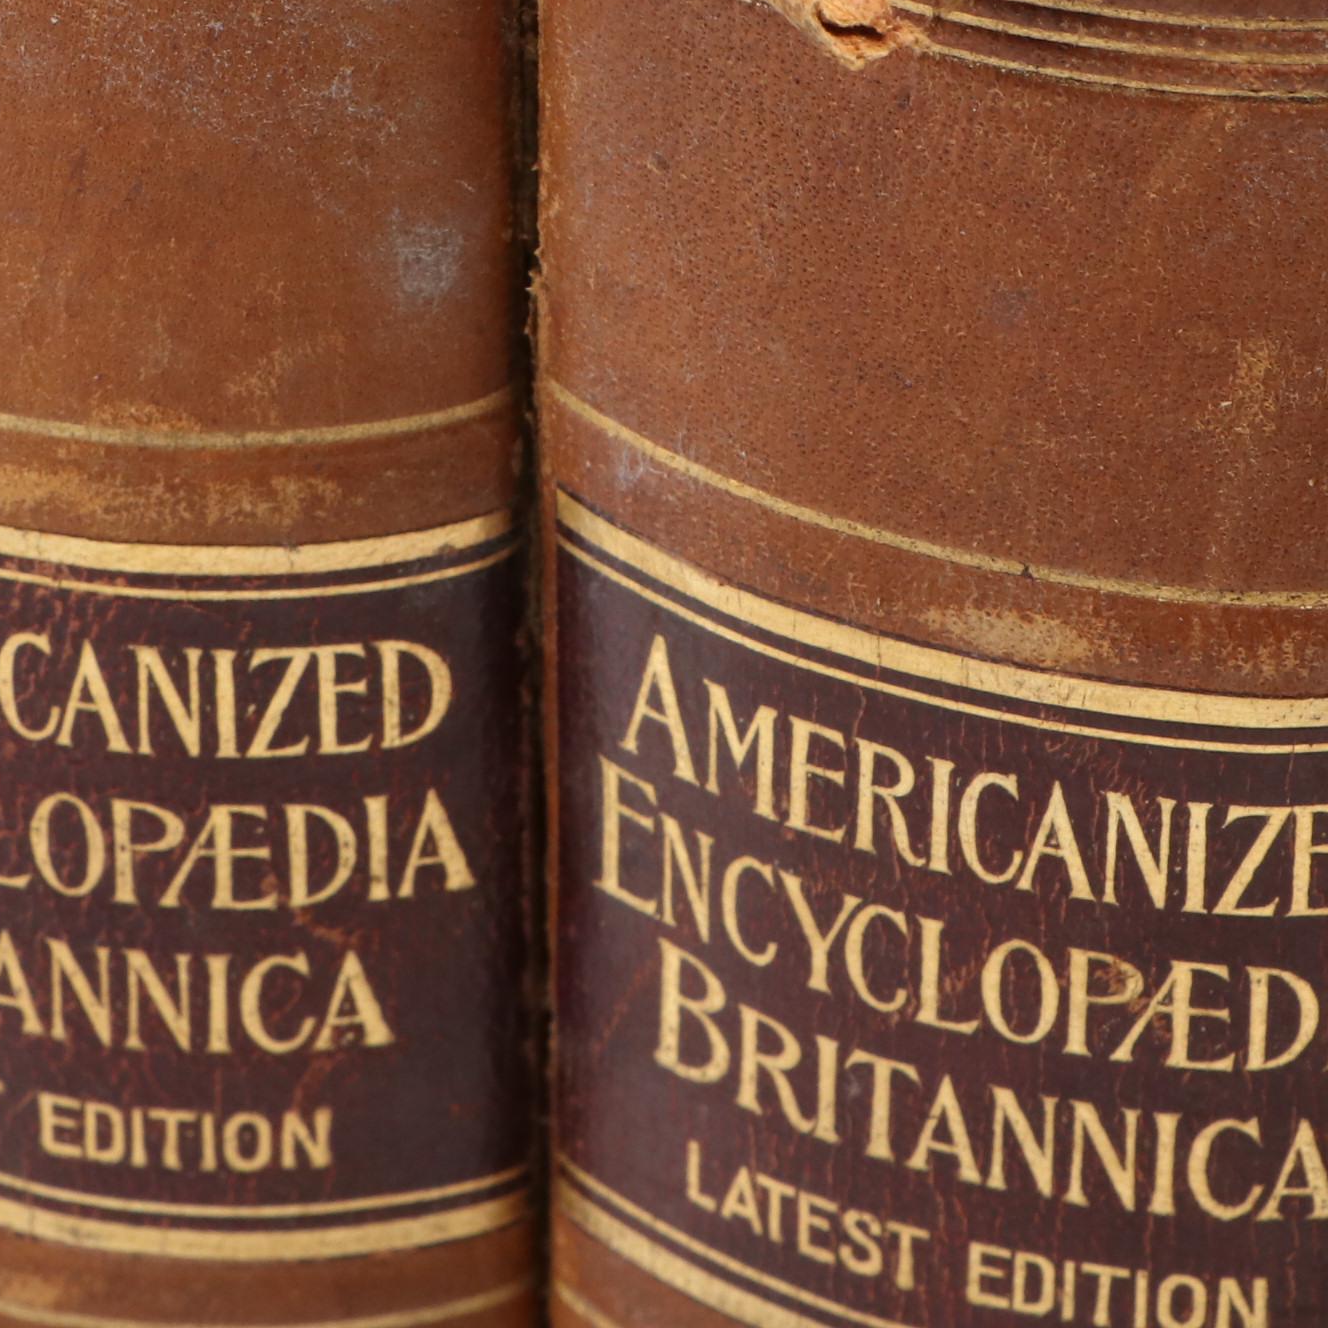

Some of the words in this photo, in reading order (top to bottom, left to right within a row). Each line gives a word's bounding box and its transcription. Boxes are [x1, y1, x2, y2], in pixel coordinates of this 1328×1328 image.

[39, 1094, 334, 1172] EDITION
[685, 1141, 930, 1291] LATEST
[966, 1241, 1268, 1328] EDITION
